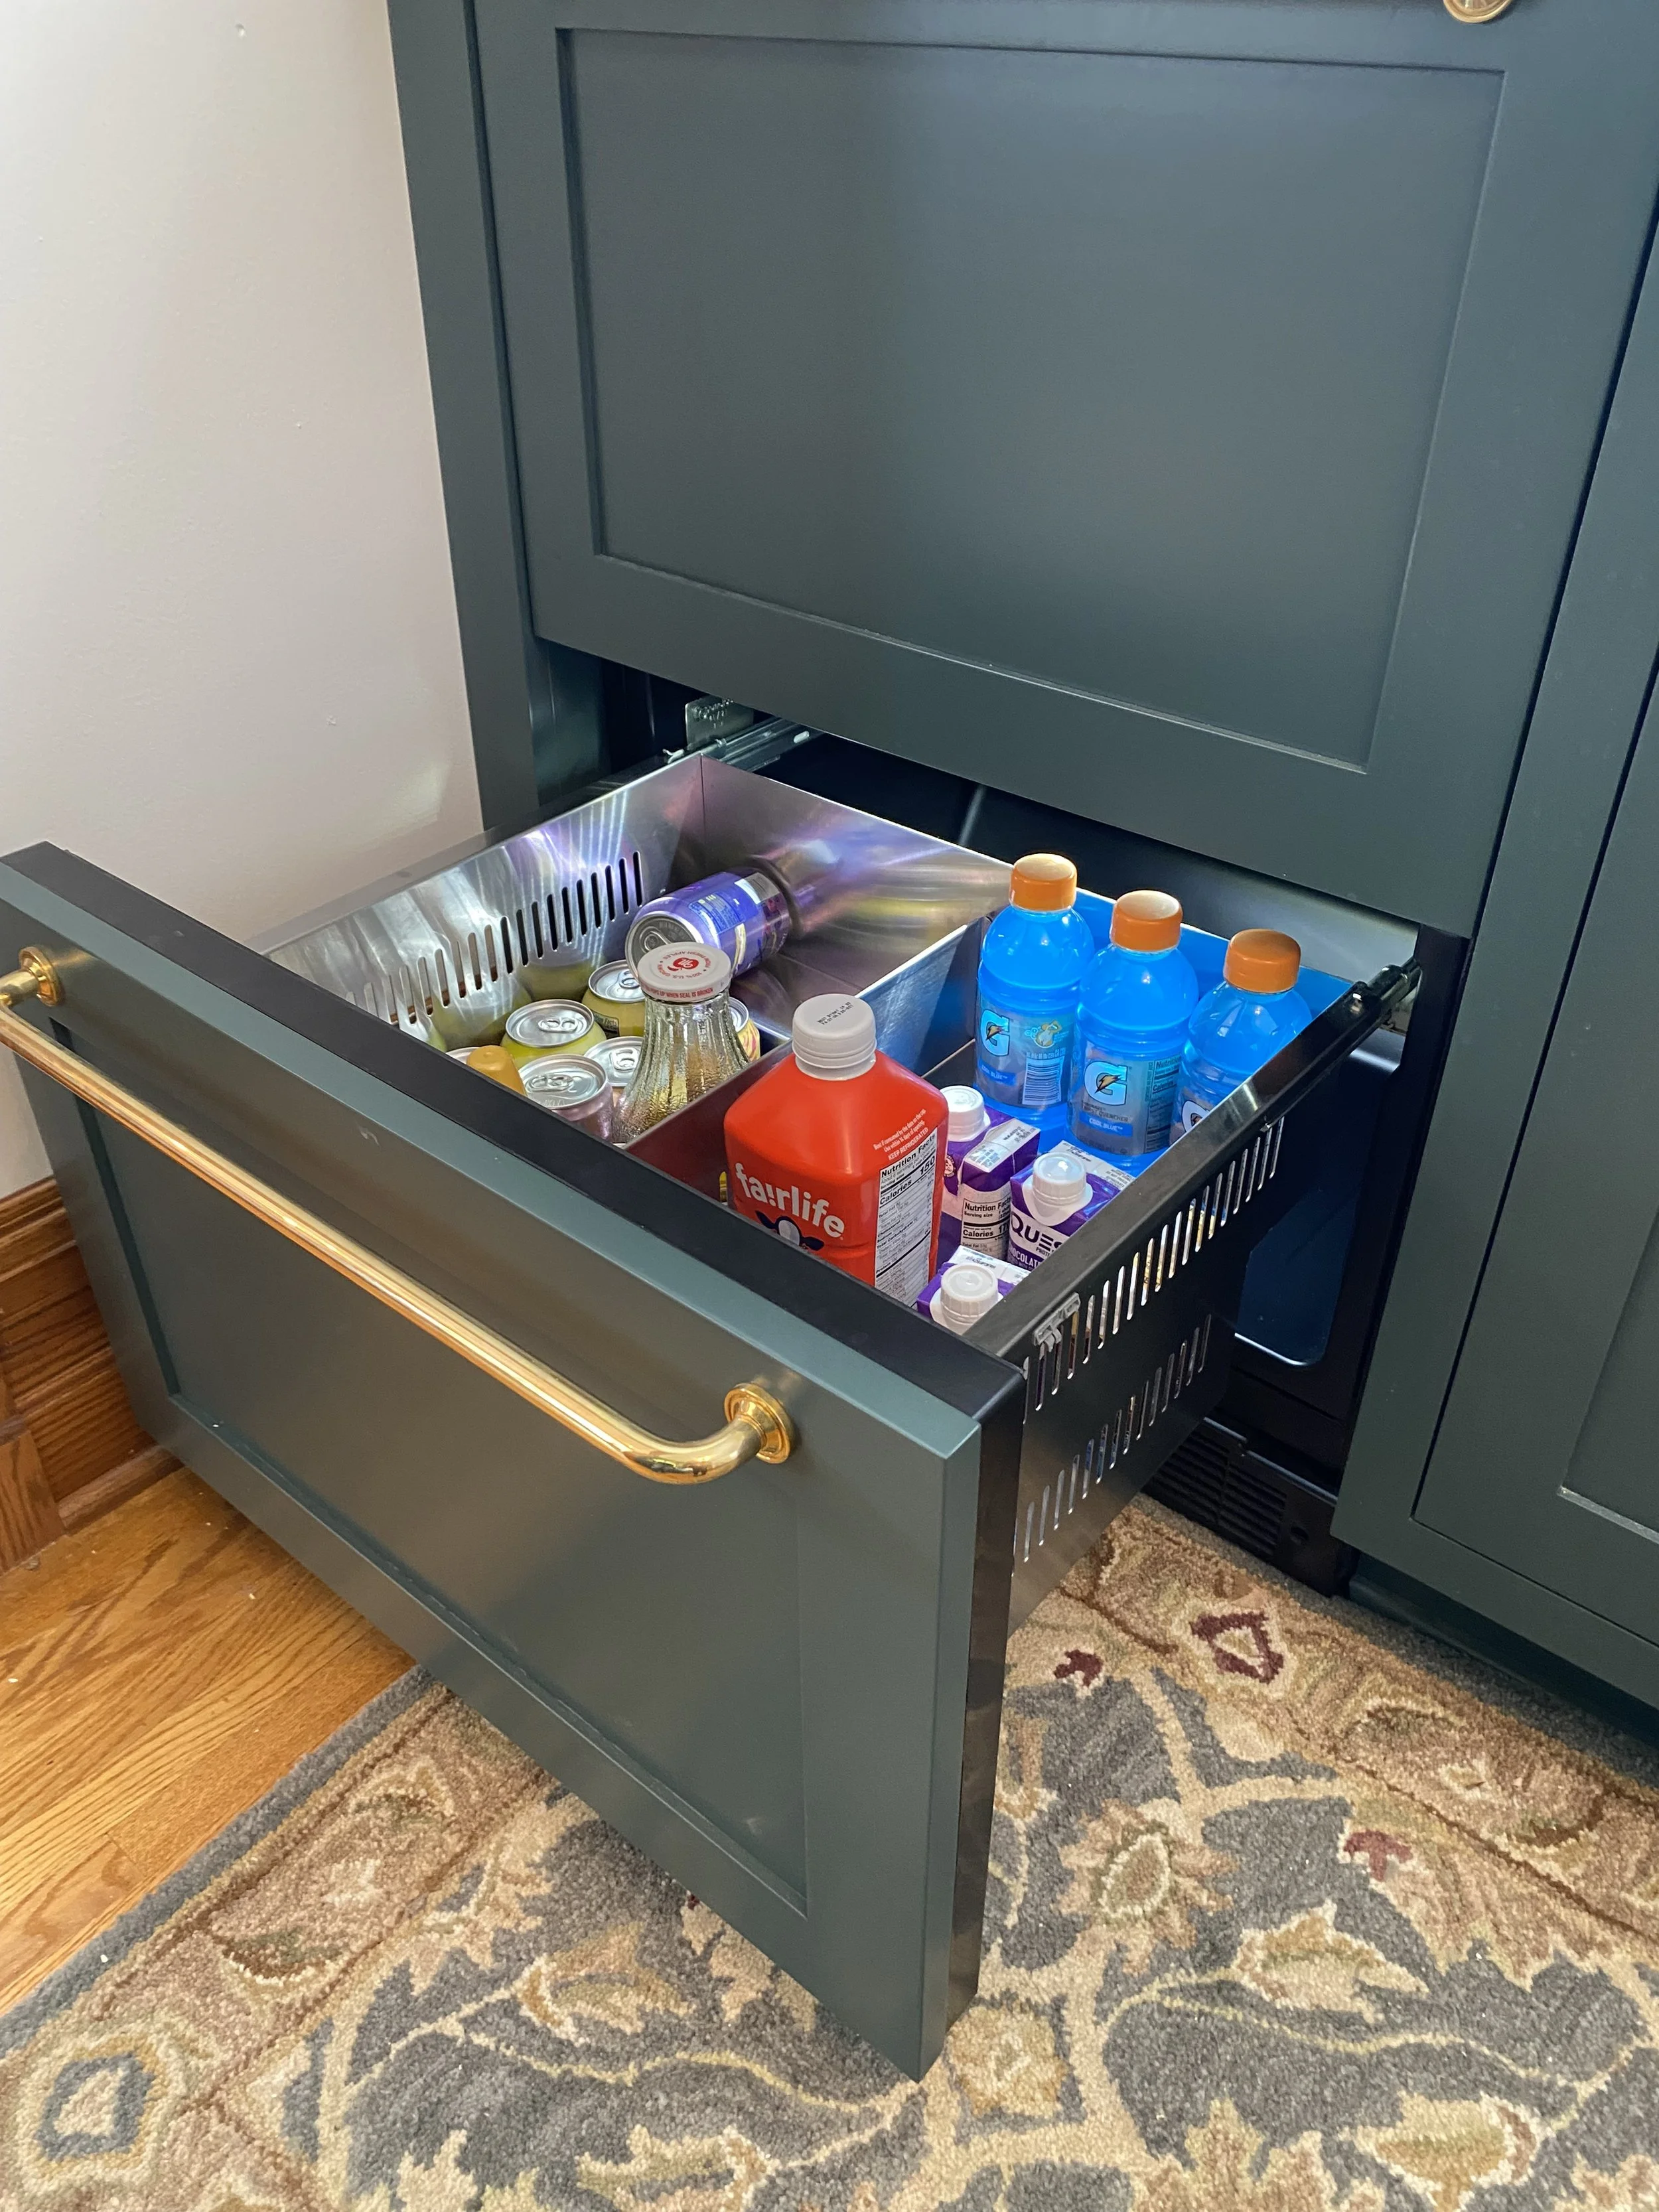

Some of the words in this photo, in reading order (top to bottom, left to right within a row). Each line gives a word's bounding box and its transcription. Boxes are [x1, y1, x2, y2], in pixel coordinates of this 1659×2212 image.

[1084, 1061, 1128, 1106] G
[881, 1153, 916, 1178] Nutrition
[918, 1134, 935, 1153] Facts
[888, 1149, 900, 1161] KEEP
[899, 1127, 928, 1153] REFRIGERATED
[880, 1179, 912, 1205] Calories
[920, 1155, 935, 1175] 150
[965, 1202, 995, 1212] Nutrition
